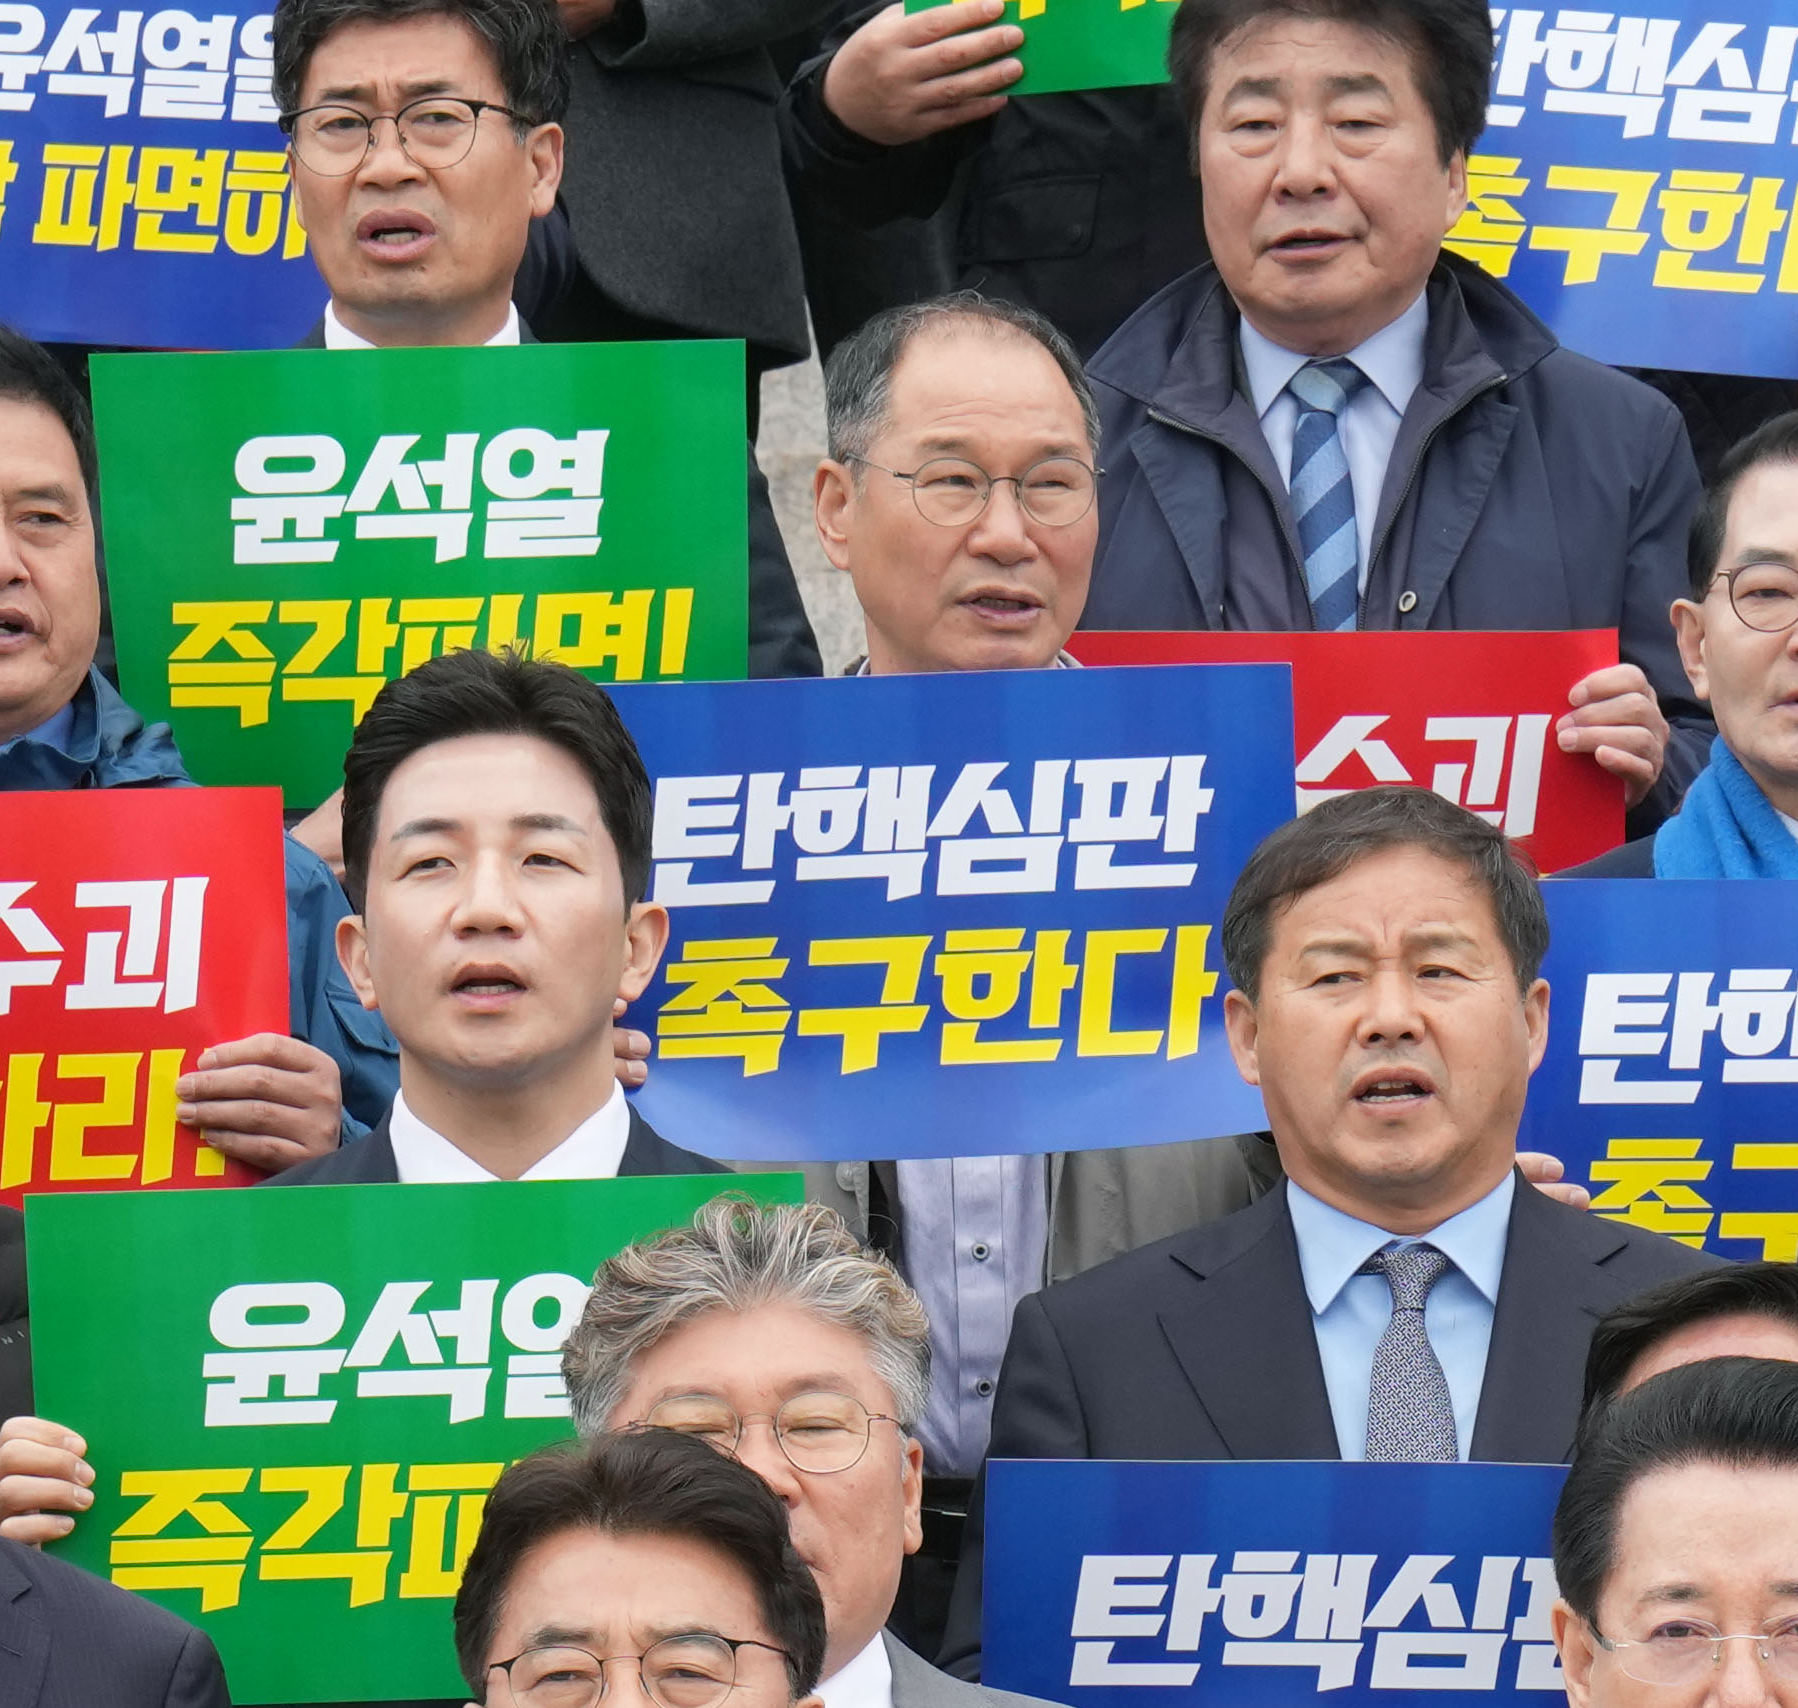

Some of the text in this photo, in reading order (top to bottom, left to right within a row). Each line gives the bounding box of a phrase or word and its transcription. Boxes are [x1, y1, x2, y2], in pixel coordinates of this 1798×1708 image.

[33, 140, 306, 261] 파면하
[231, 427, 610, 564] 윤석열
[652, 754, 1215, 908] 탄핵심판
[657, 925, 1219, 1078] 촉구한다
